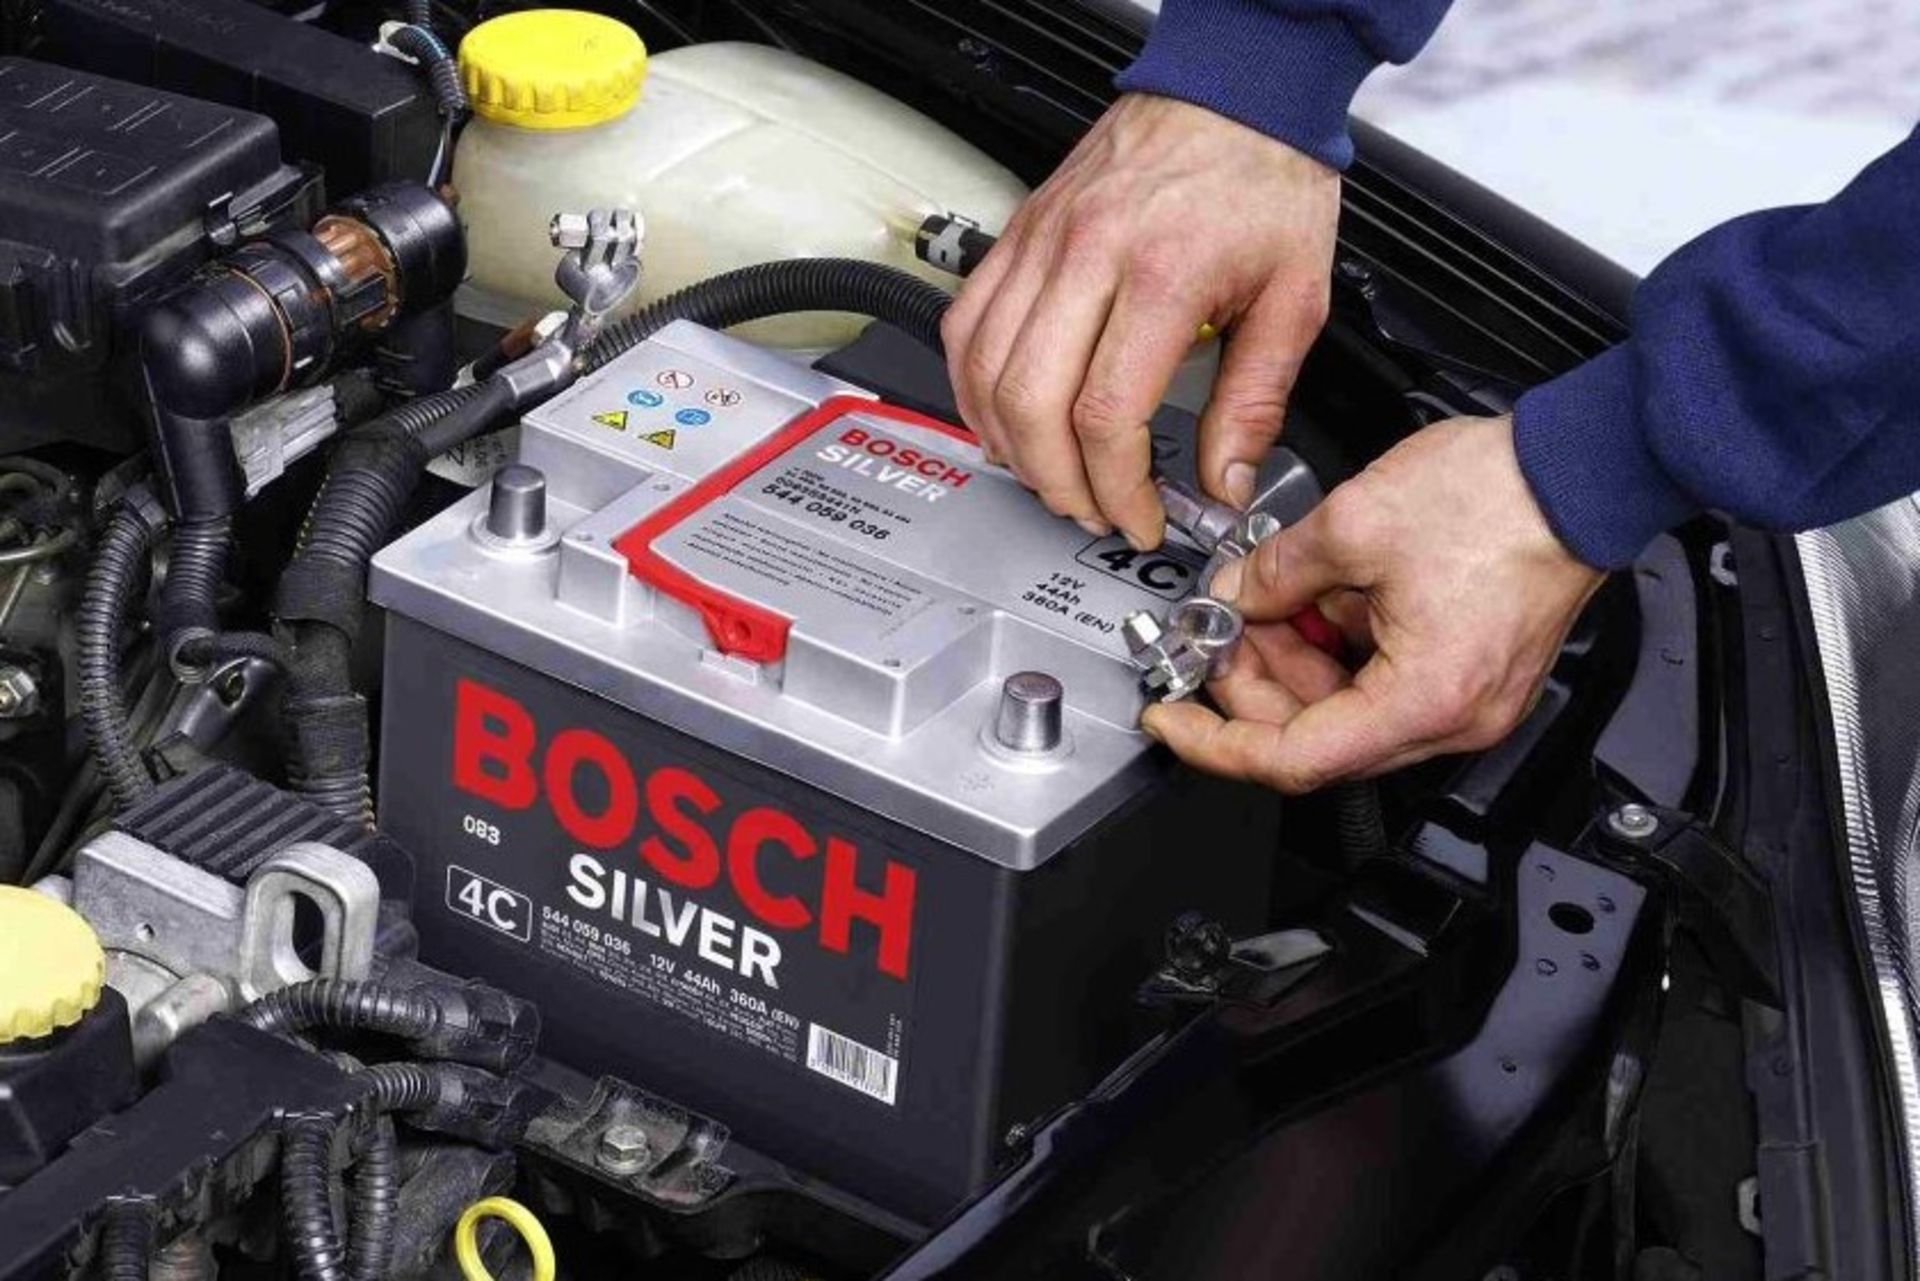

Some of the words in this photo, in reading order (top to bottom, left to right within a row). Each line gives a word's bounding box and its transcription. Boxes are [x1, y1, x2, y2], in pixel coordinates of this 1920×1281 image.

[816, 444, 948, 503] SILVER
[838, 428, 976, 488] BOSCH
[762, 483, 804, 505] 544
[805, 501, 848, 522] 059
[849, 519, 891, 540] 036
[1035, 583, 1081, 606] 44Ah
[1050, 572, 1086, 590] 12V
[1097, 550, 1189, 590] 4C
[1022, 591, 1069, 615] 360A
[1074, 611, 1115, 634] (EN)
[451, 676, 919, 982] BOSCH
[462, 814, 501, 846] 083
[458, 878, 517, 932] 4C
[565, 853, 784, 990] SILVER
[542, 906, 570, 928] 544
[572, 919, 600, 941] 059
[604, 933, 632, 956] 036
[650, 954, 676, 974] 12V
[683, 970, 721, 996] 44Ah
[730, 988, 769, 1016] 360A
[770, 1008, 800, 1030] (EN)
